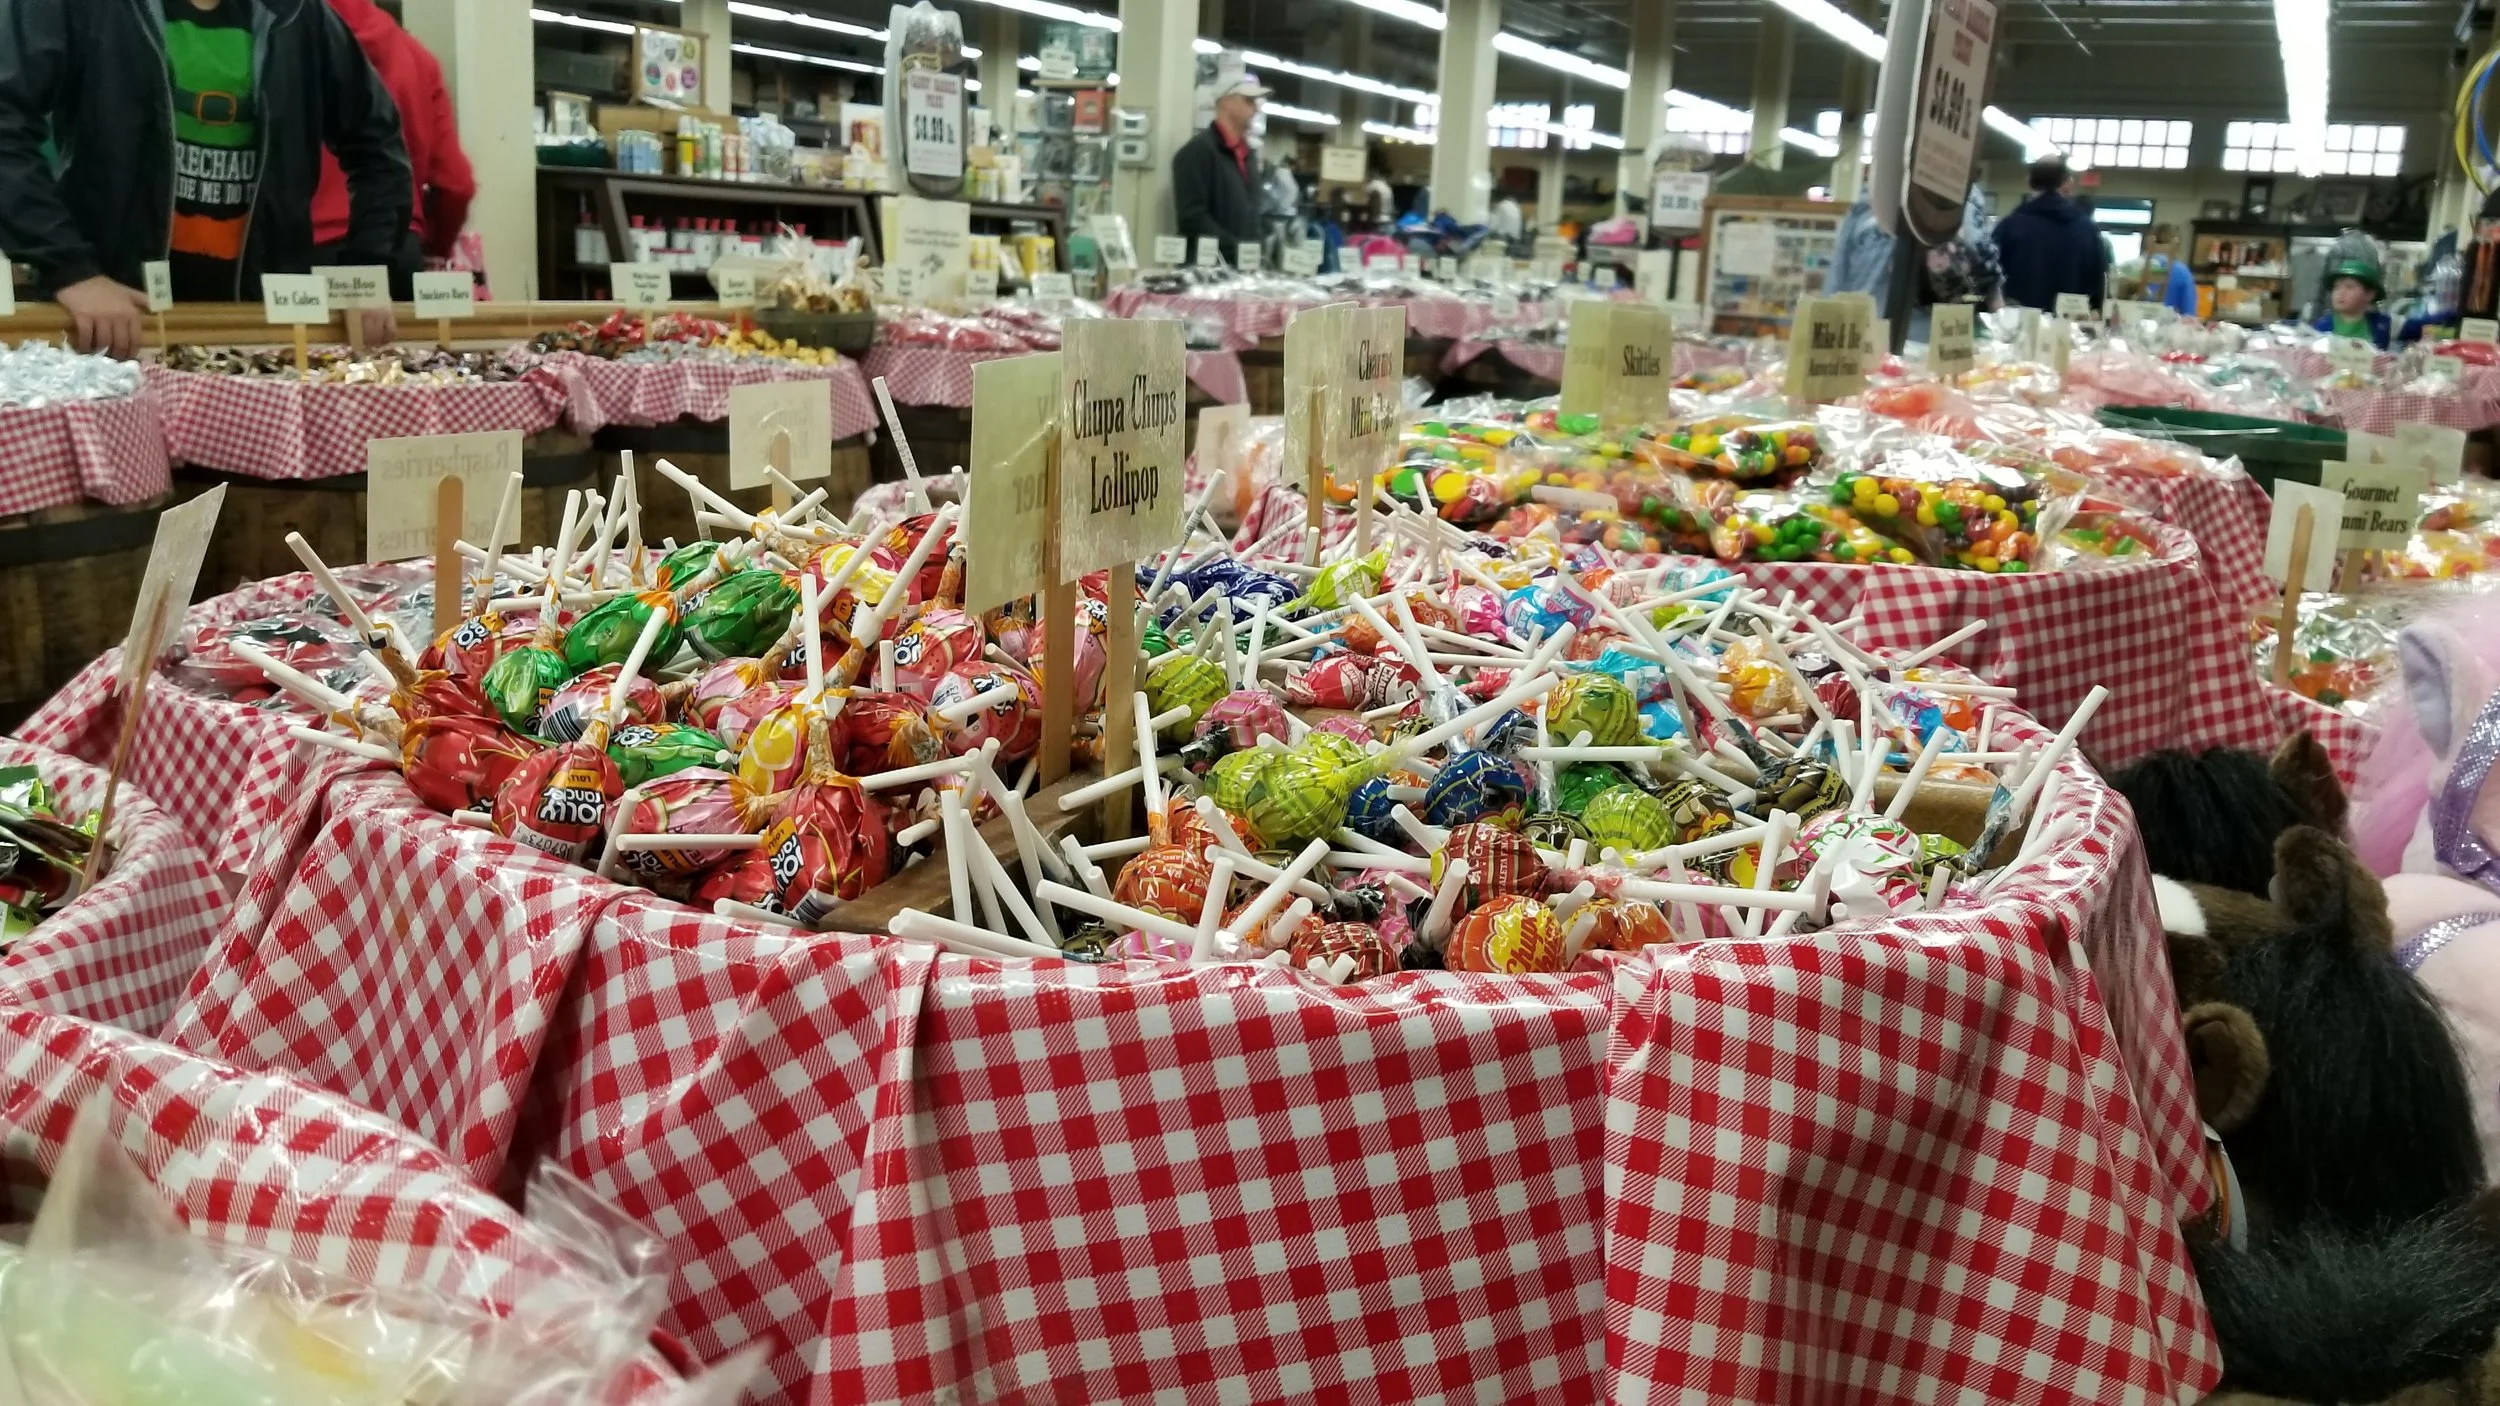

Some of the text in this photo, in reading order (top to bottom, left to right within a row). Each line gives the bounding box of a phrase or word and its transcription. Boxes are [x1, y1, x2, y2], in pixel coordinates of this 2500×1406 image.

[176, 141, 256, 181] RECHAU
[178, 177, 197, 200] DE
[201, 181, 221, 204] ME
[273, 290, 320, 306] Ice Cubes
[1812, 322, 1836, 350] Mike
[1359, 339, 1393, 381] Charms
[1622, 344, 1661, 377] Skittles
[1073, 374, 1177, 446] Chupa Chups
[1350, 396, 1372, 439] Mini
[1091, 451, 1159, 515] Lollipop
[2342, 477, 2400, 503] Gourmet
[2370, 510, 2408, 533] Bears
[1375, 664, 1396, 706] CHARM
[568, 774, 592, 782] LOLL
[540, 799, 605, 824] JOLLY
[1507, 915, 1544, 973] Chup
